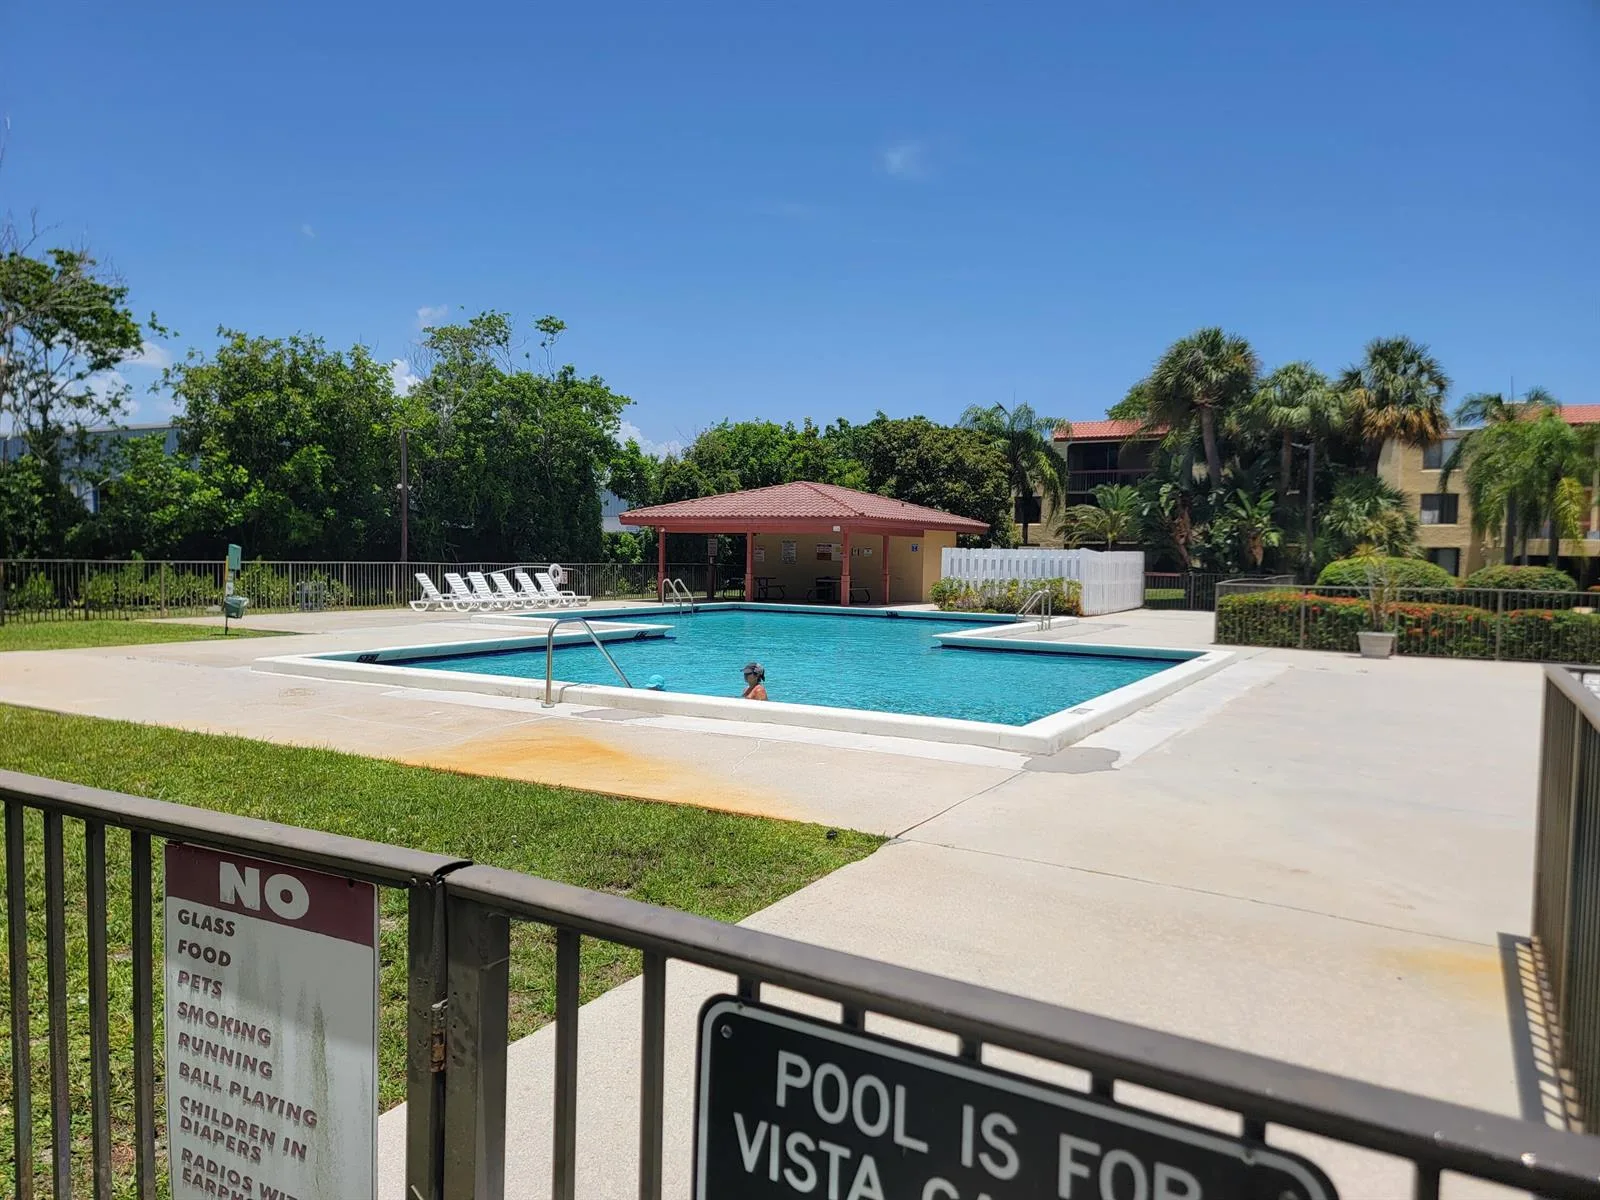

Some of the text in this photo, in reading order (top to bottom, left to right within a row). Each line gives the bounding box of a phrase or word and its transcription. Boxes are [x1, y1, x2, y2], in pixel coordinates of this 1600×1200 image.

[219, 861, 310, 920] NO
[178, 909, 236, 937] GLASS
[177, 939, 232, 967] FOOD
[177, 970, 223, 998] PETS
[177, 1001, 272, 1046] SMOKING
[178, 1032, 273, 1079] RUNNING
[179, 1062, 318, 1128] BALL PLAYING
[776, 1049, 929, 1154] POOL
[960, 1103, 1020, 1180] IS
[180, 1096, 307, 1162] CHILDREN IN
[180, 1115, 262, 1163] DIAPERS
[181, 1147, 253, 1193] RADIOS
[733, 1111, 886, 1200] VISTA
[181, 1167, 253, 1200] EARPH
